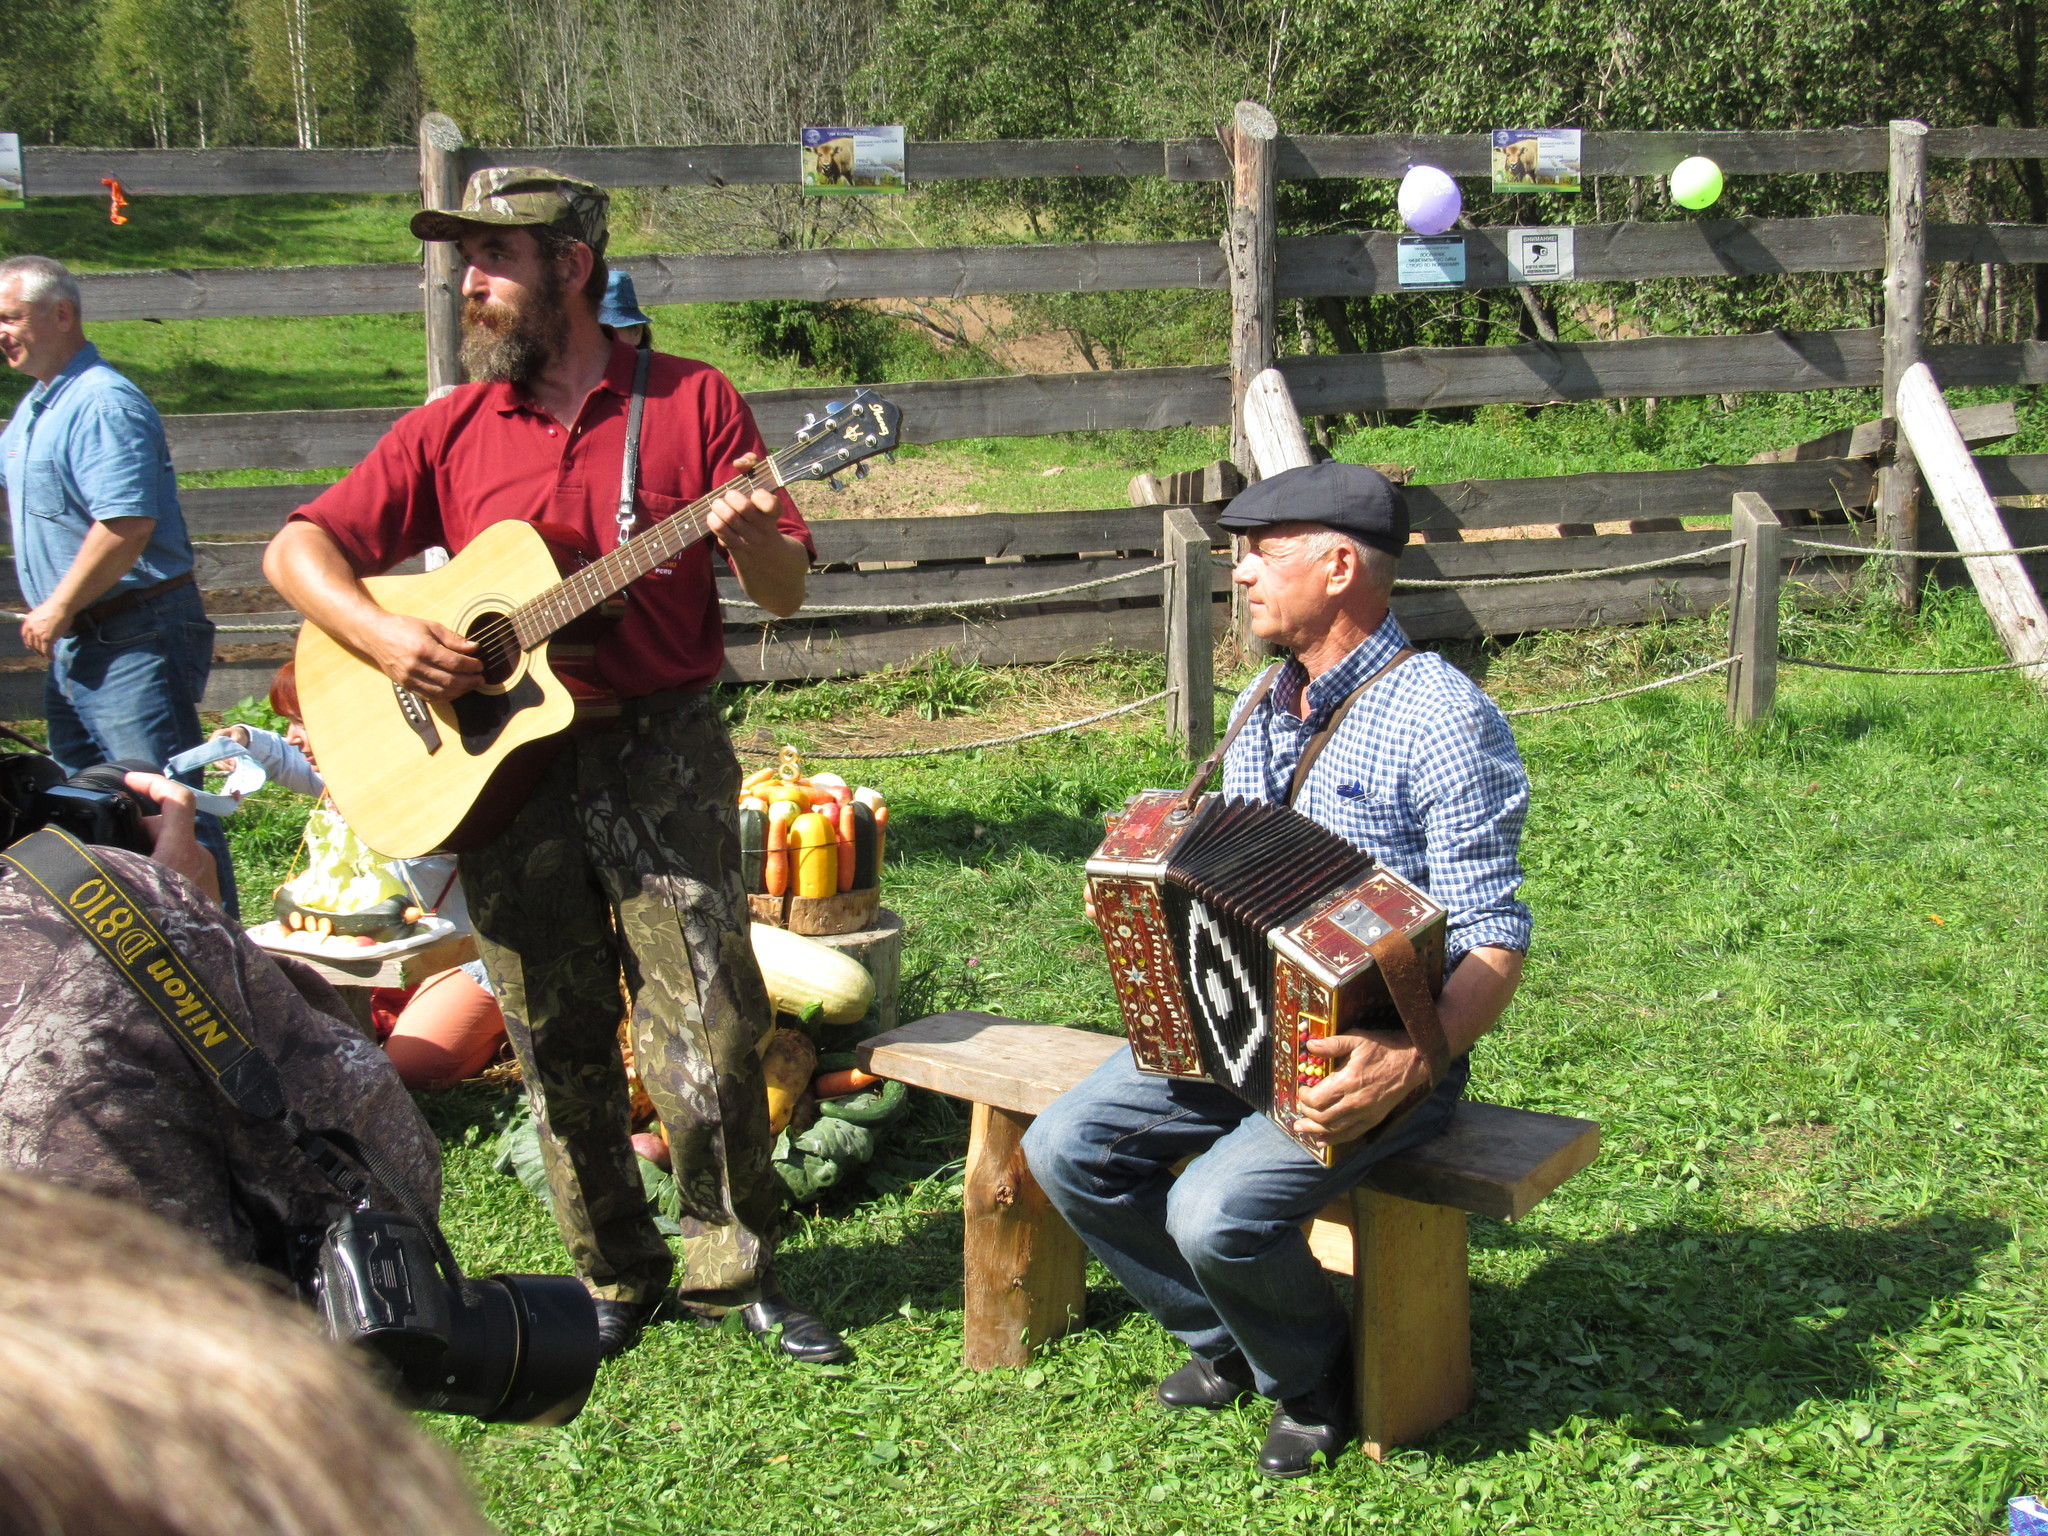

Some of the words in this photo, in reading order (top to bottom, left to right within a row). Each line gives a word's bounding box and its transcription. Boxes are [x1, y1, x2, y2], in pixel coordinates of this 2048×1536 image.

[868, 403, 890, 436] Ibanez
[69, 878, 157, 965] D810
[147, 958, 229, 1048] Nikon
[1151, 934, 1182, 1027] ЛЮБИТЕЛЬСКАЯ
